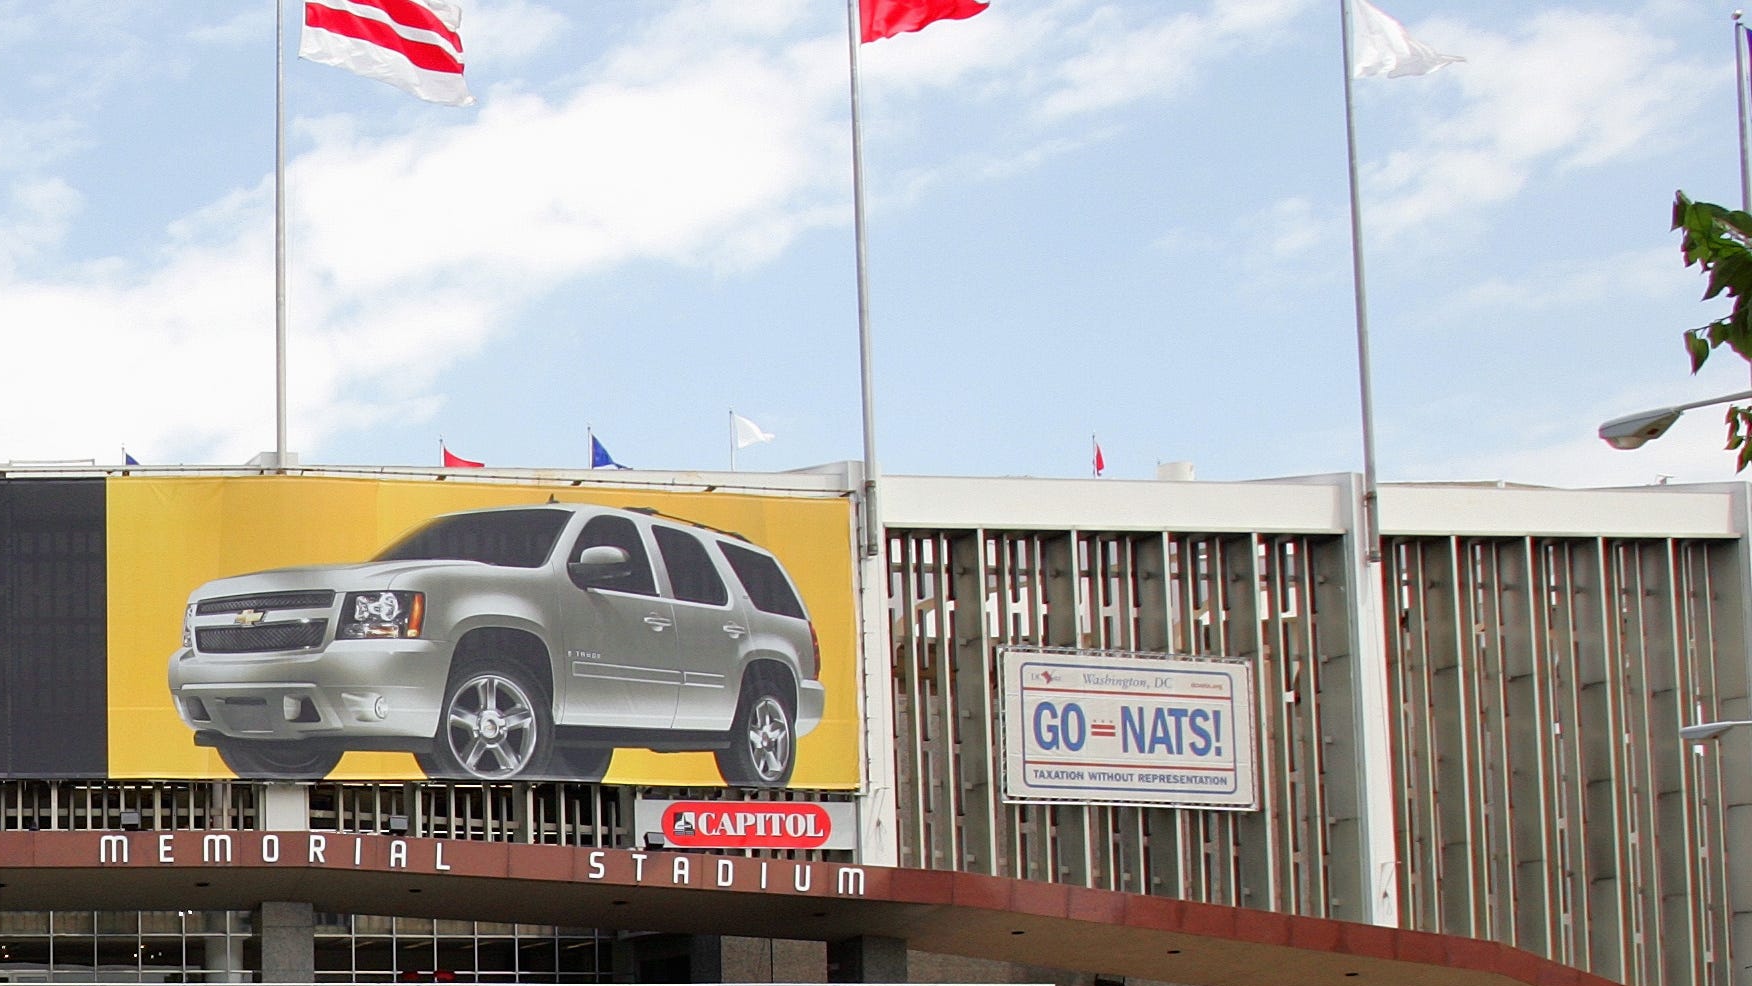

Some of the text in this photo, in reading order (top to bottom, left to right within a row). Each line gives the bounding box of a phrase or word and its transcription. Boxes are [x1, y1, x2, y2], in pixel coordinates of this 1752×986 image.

[1083, 672, 1173, 690] Washington, DC
[1033, 701, 1222, 757] GO NATS!
[1033, 769, 1228, 786] TAXATION WITHOUT REPRESENTATION
[698, 812, 825, 838] CAPITOL
[100, 834, 451, 871] MEMORIAL
[588, 851, 865, 896] STADIUM
